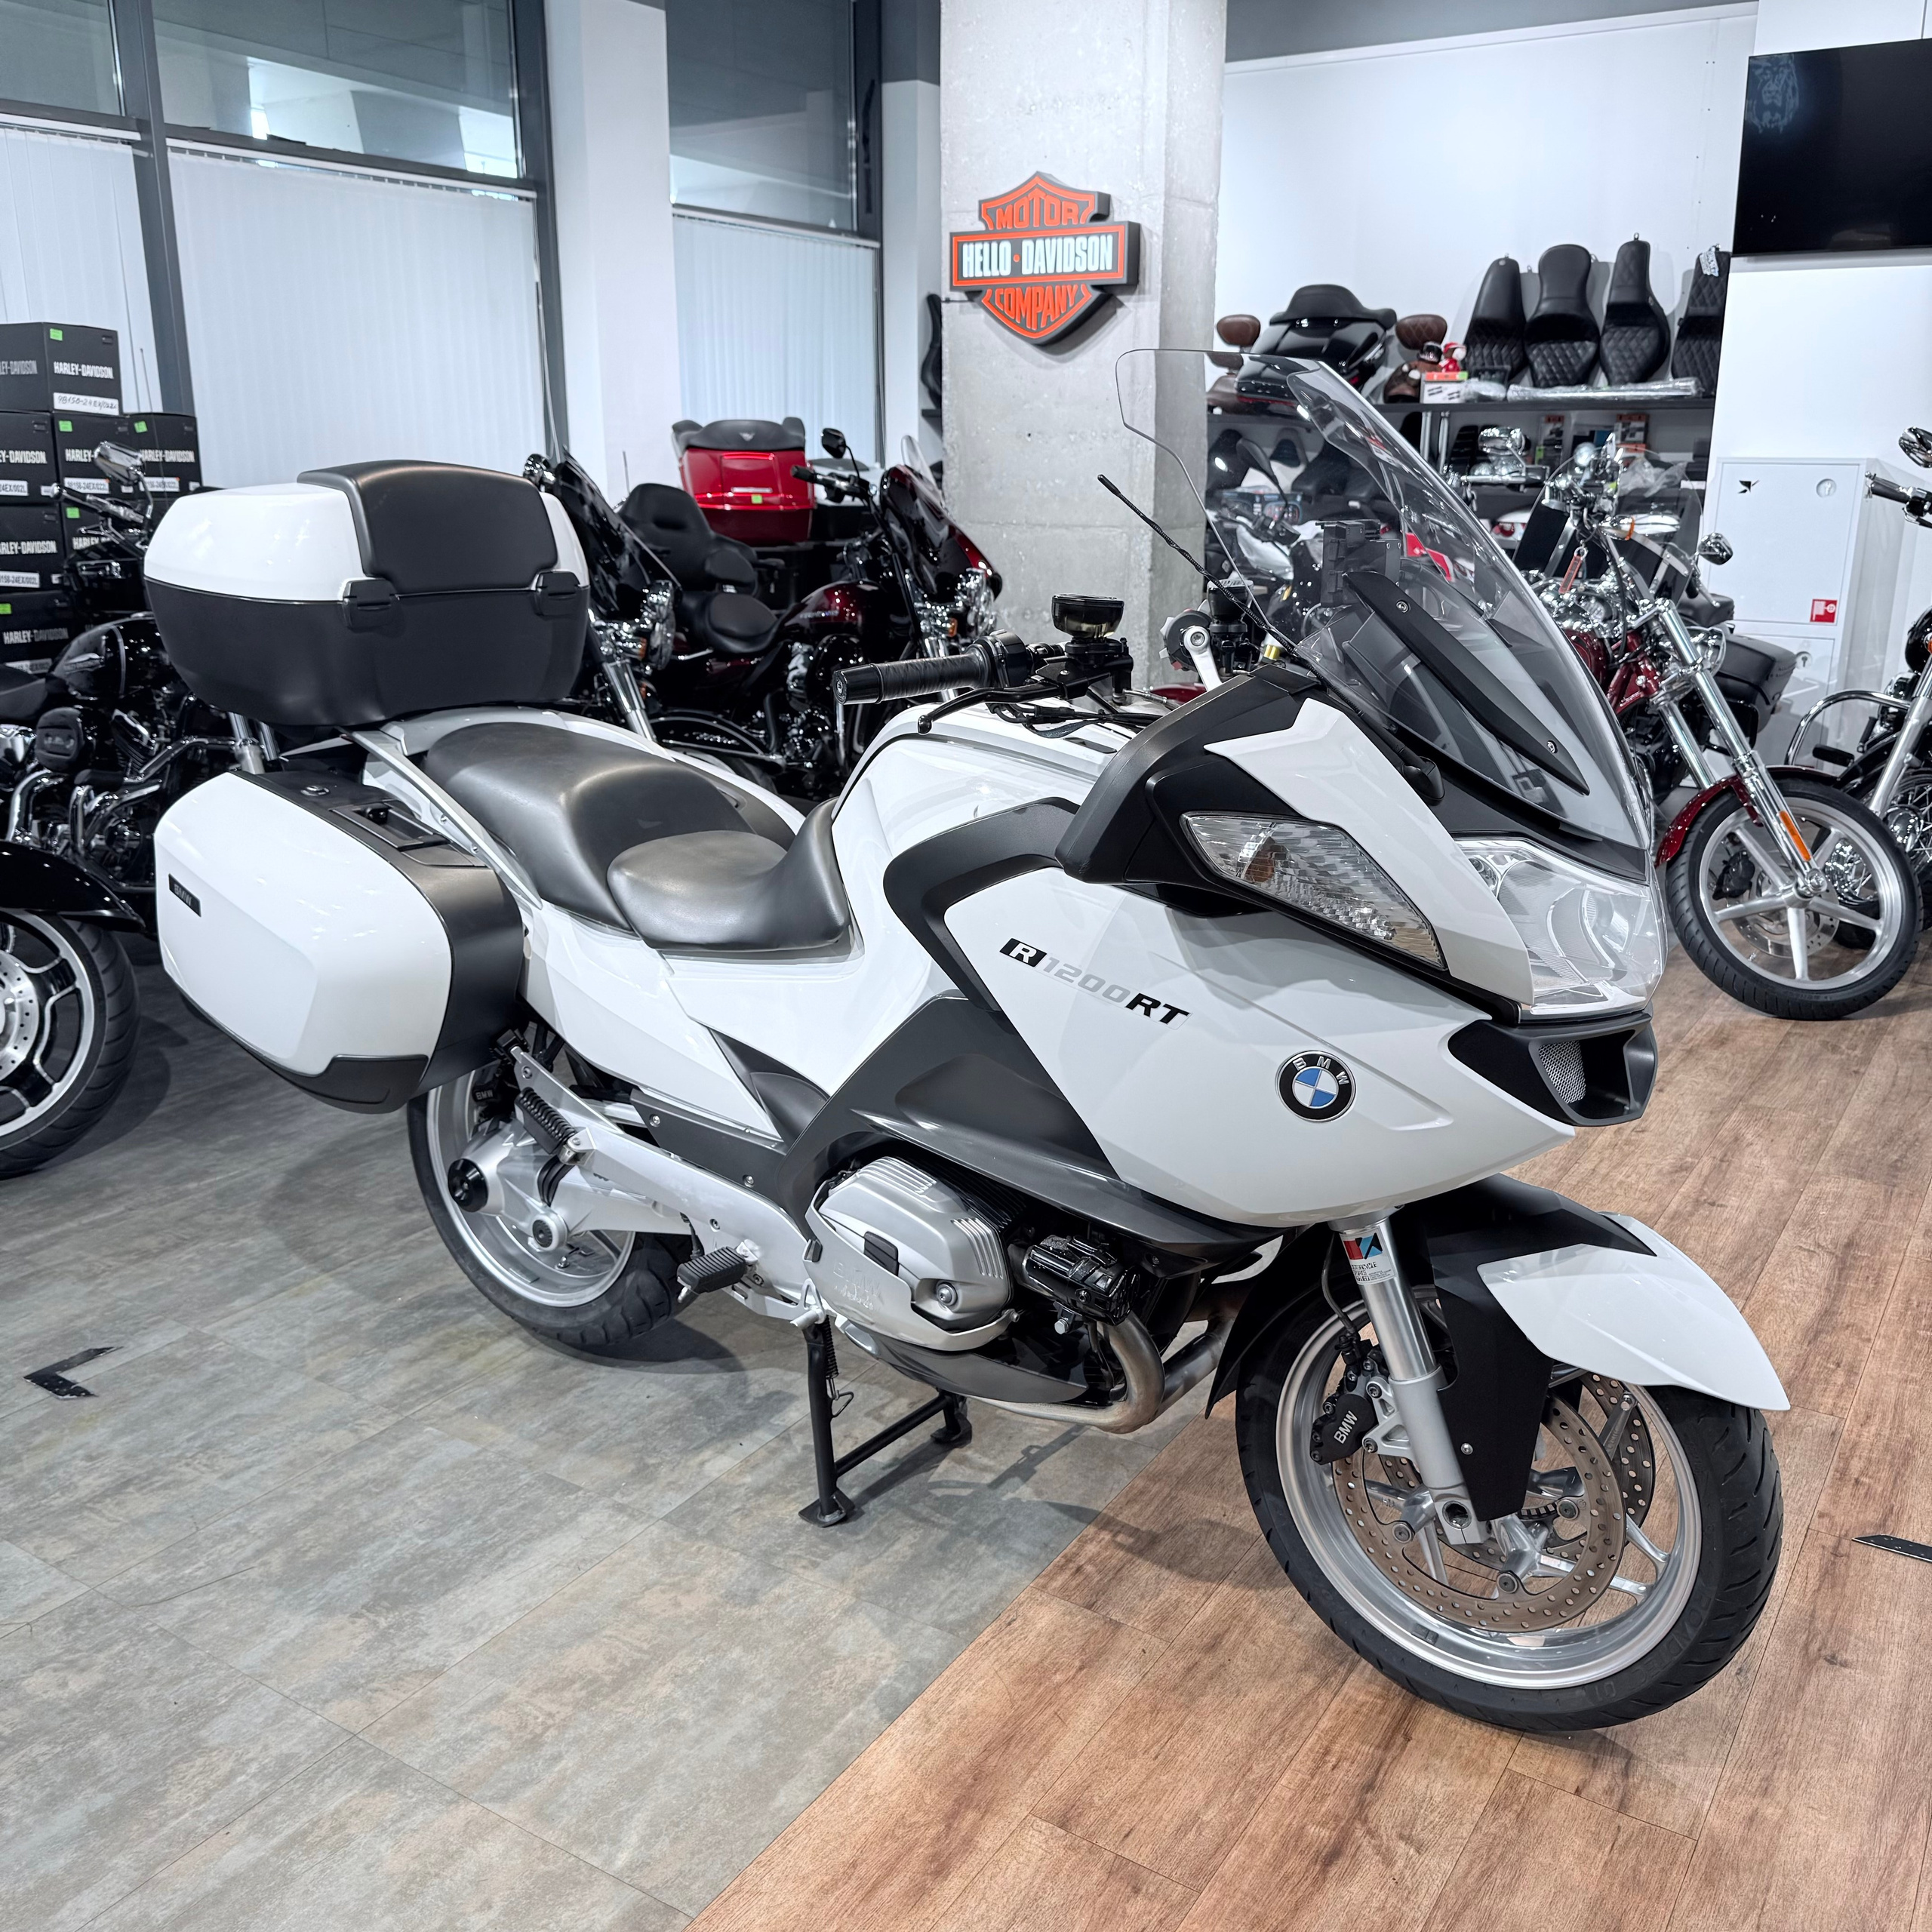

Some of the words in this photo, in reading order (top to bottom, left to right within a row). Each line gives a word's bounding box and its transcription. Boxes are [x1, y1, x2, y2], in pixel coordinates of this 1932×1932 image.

[995, 188, 1079, 230] MOTOR
[962, 241, 1012, 278] HELLO
[1021, 234, 1113, 275] DAVIDSON
[995, 284, 1079, 331] COMPANY
[54, 361, 114, 379] HARLEY-DAVIDSON
[3, 628, 69, 645] HARLEY-DAVIDSON
[174, 884, 192, 906] BMW
[1293, 1056, 1349, 1085] BMW
[475, 1090, 494, 1100] BMW
[1334, 1410, 1358, 1444] BMW
